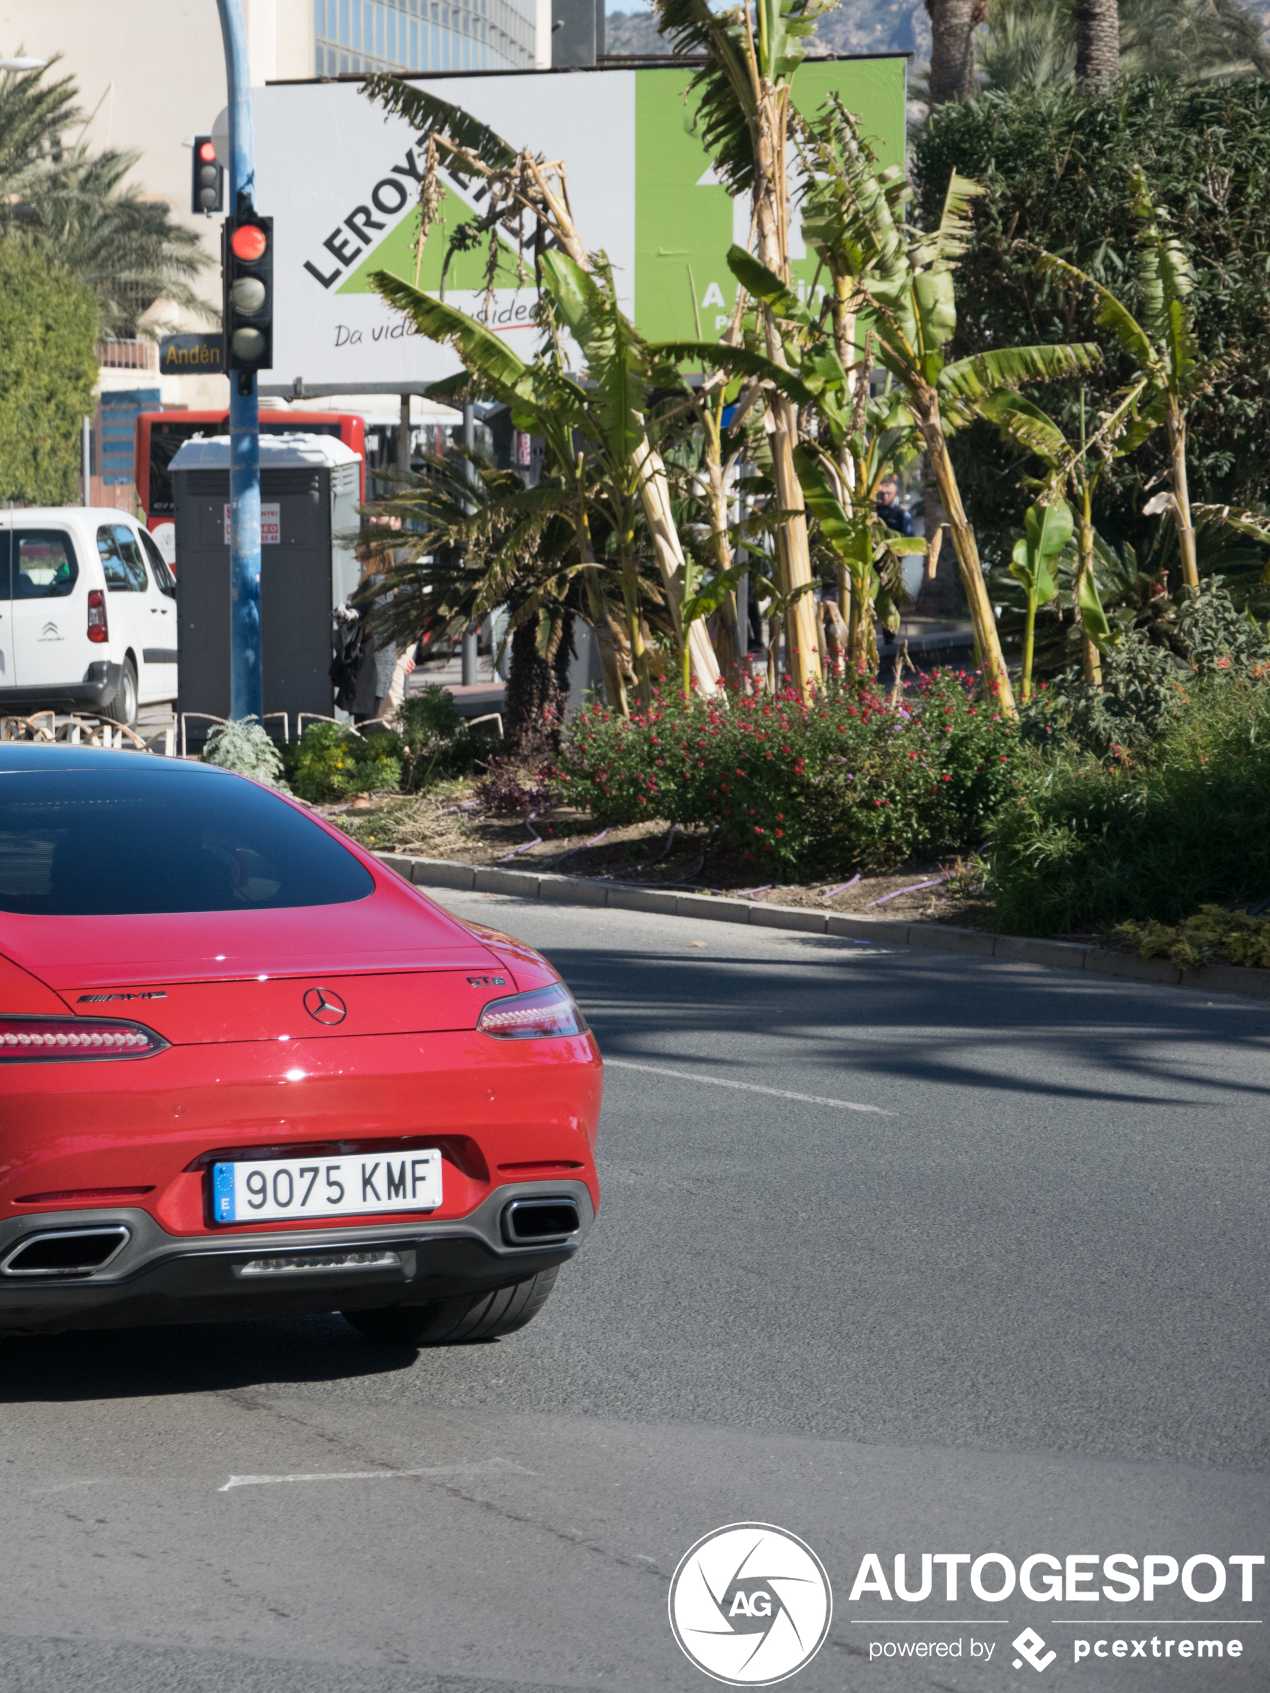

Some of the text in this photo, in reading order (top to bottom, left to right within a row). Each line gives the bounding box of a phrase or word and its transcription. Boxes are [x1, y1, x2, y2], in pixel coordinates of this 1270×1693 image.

[303, 147, 425, 289] LEROY
[702, 282, 725, 308] A
[335, 325, 362, 347] Da
[166, 344, 220, 365] Andén
[221, 1158, 430, 1210] E 9075 KMF
